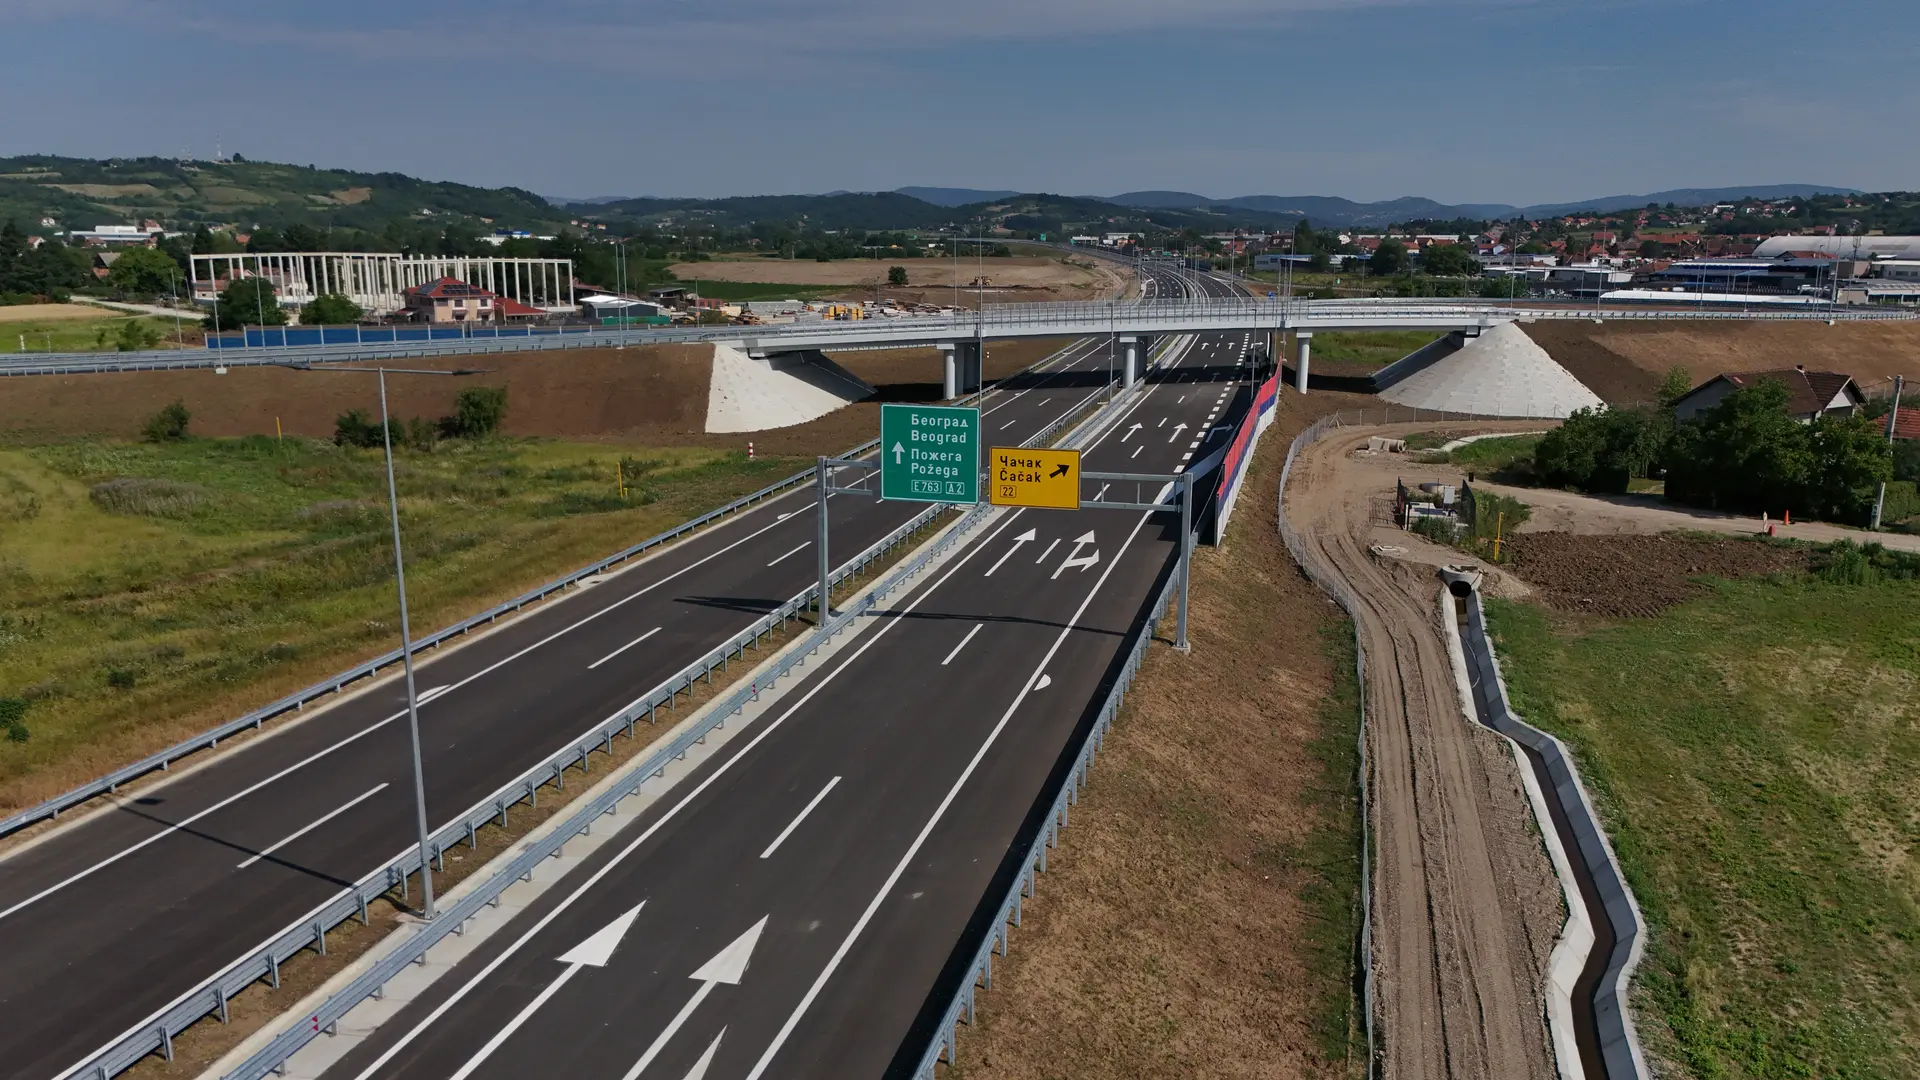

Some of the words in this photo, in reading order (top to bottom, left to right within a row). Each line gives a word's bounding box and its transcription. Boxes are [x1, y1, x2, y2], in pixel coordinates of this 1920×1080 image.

[911, 413, 969, 430] Београд
[911, 430, 967, 445] Beograd
[911, 448, 962, 462] Пожега
[1000, 455, 1042, 468] Чачак
[911, 462, 959, 478] Požega
[1000, 467, 1042, 483] Čačak
[1002, 486, 1014, 497] 22
